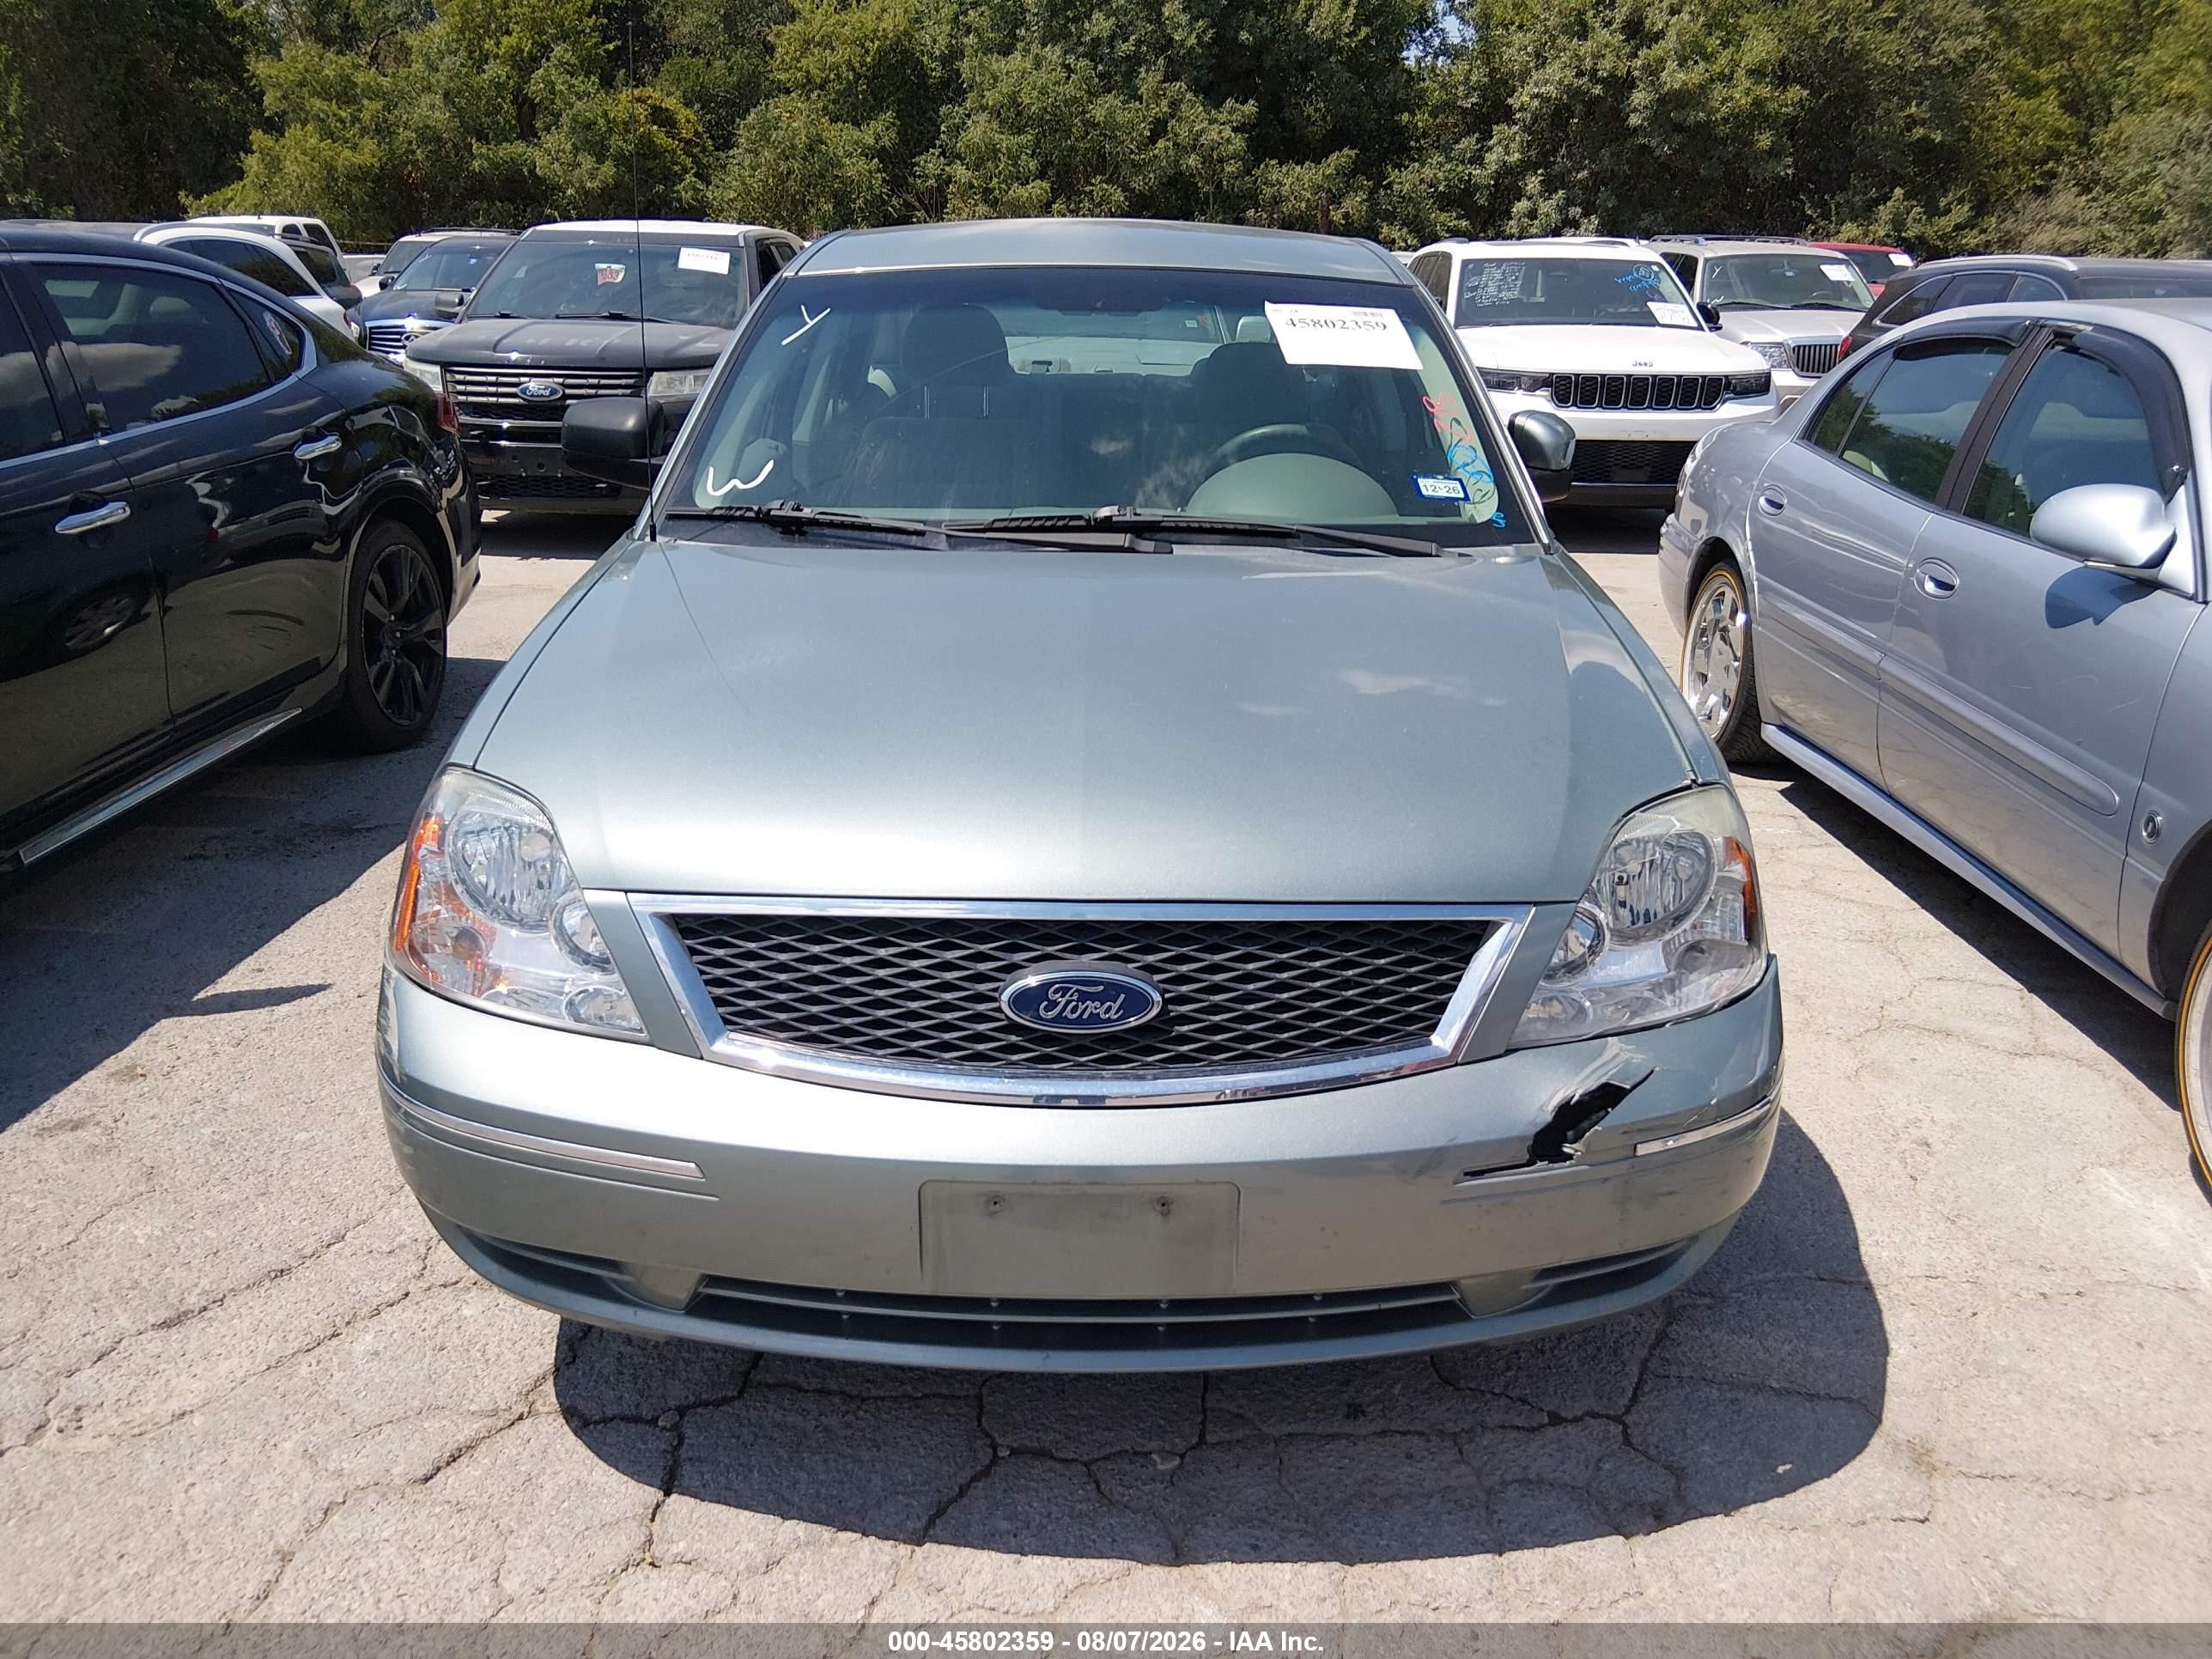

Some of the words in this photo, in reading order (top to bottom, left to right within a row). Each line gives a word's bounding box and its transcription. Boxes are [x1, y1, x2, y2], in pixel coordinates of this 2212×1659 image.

[1711, 265, 1723, 279] Y
[781, 303, 832, 346] Y
[1285, 317, 1388, 331] 45802359
[526, 385, 552, 397] Ford
[1038, 983, 1127, 1019] Ford
